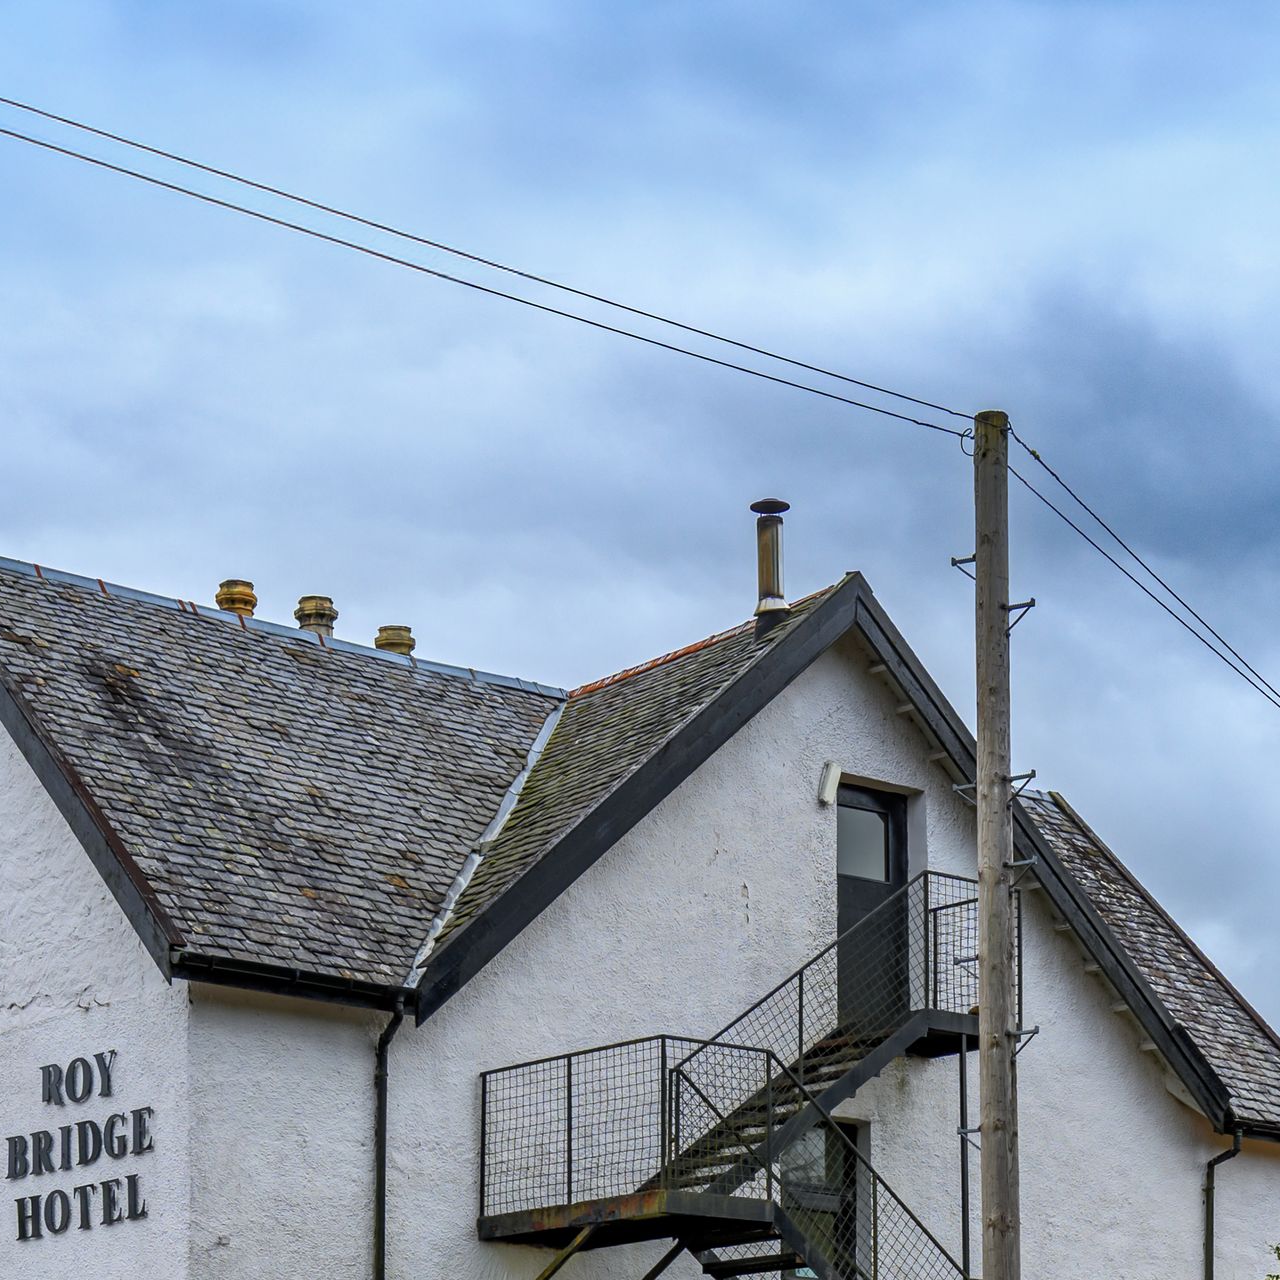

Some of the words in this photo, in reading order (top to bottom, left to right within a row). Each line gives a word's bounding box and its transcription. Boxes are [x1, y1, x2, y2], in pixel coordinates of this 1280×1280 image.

[39, 1049, 117, 1106] ROY
[4, 1106, 154, 1180] BRIDGE
[14, 1173, 148, 1241] HOTEL
